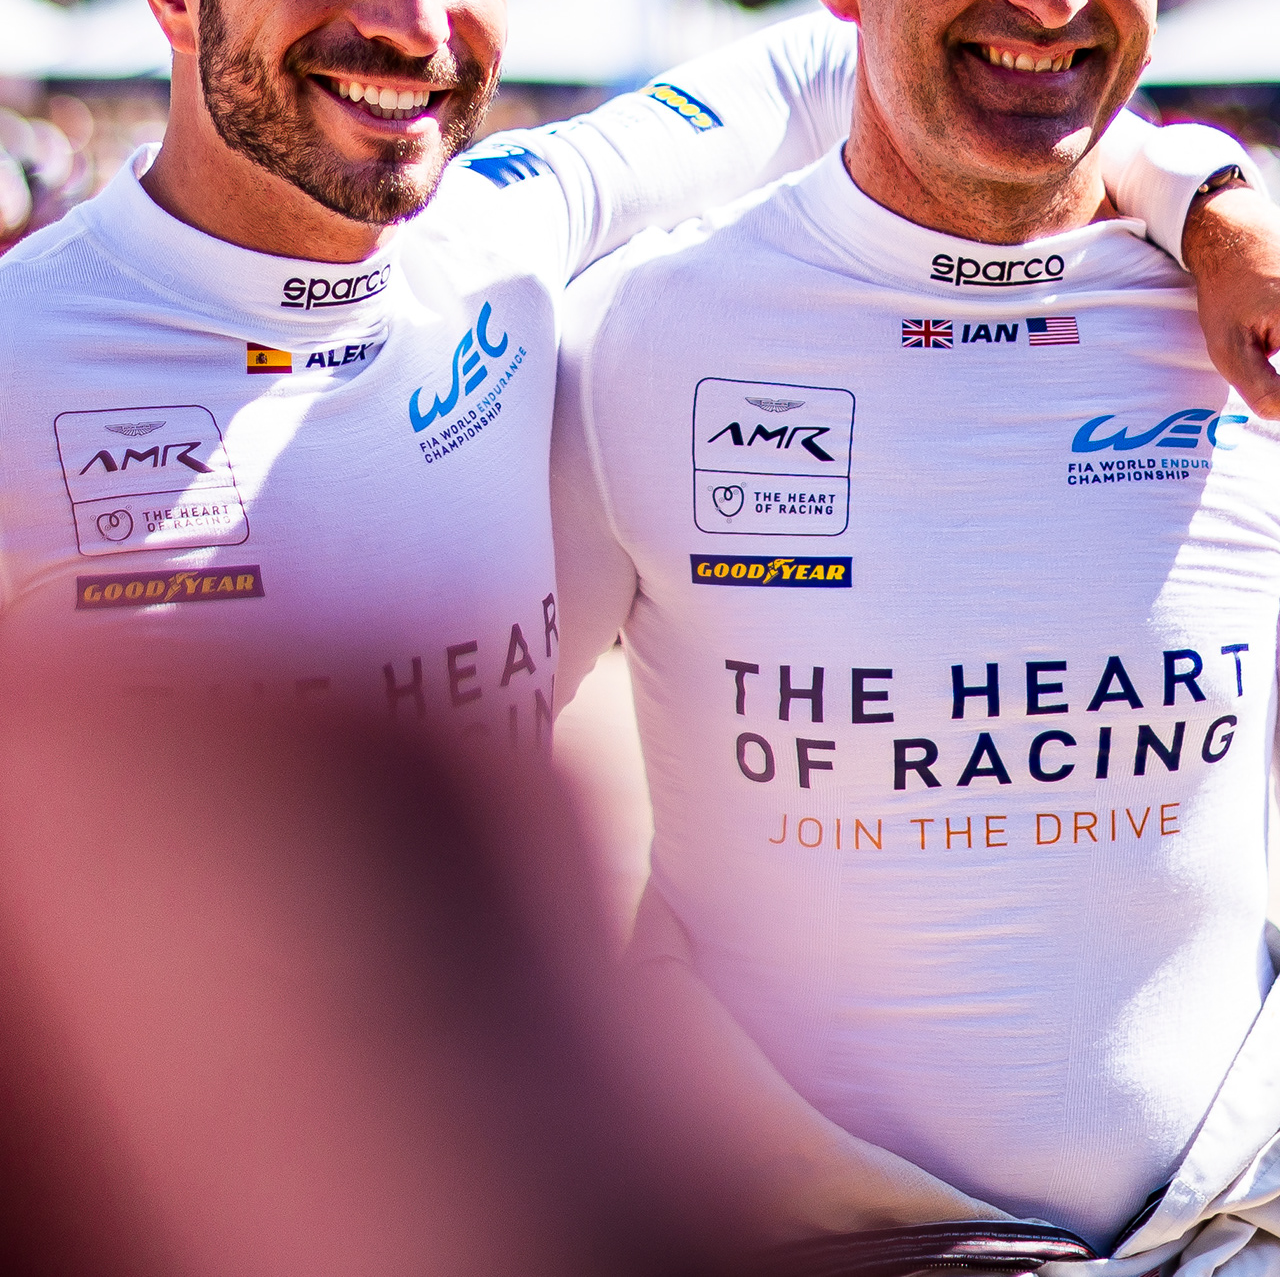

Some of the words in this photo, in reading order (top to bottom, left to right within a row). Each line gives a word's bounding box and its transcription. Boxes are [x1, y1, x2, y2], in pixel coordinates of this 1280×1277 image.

[930, 254, 1064, 286] sparco
[281, 264, 391, 310] sparco
[962, 323, 1019, 343] IAN
[306, 342, 374, 368] ALEX
[409, 301, 508, 433] WEC
[420, 437, 440, 452] FIA
[440, 410, 477, 440] WORLD
[476, 346, 527, 413] ENDURANCE
[424, 402, 502, 463] CHAMPIONSHIP
[707, 422, 835, 461] AMR
[1072, 408, 1249, 453] WEC
[79, 441, 215, 475] AMR
[1068, 463, 1094, 473] FIA
[1100, 459, 1156, 471] WORLD
[1161, 459, 1210, 469] ENDUR
[1067, 471, 1190, 486] CHAMPIONSHIP
[143, 509, 173, 522] THE
[180, 505, 229, 518] HEART
[754, 492, 781, 502] THE
[788, 493, 836, 504] HEART
[755, 503, 772, 513] OF
[779, 504, 833, 515] RACING
[147, 522, 165, 533] OF
[83, 572, 255, 602] GOODYEAR
[697, 559, 845, 584] GOODYEAR
[383, 592, 559, 716] HEAR
[725, 659, 894, 724] THE
[950, 643, 1249, 719] HEART
[736, 732, 836, 789] OF
[892, 715, 1238, 790] RACING
[768, 813, 883, 850] JOIN
[910, 814, 1009, 850] THE
[1035, 802, 1181, 846] DRIVE
